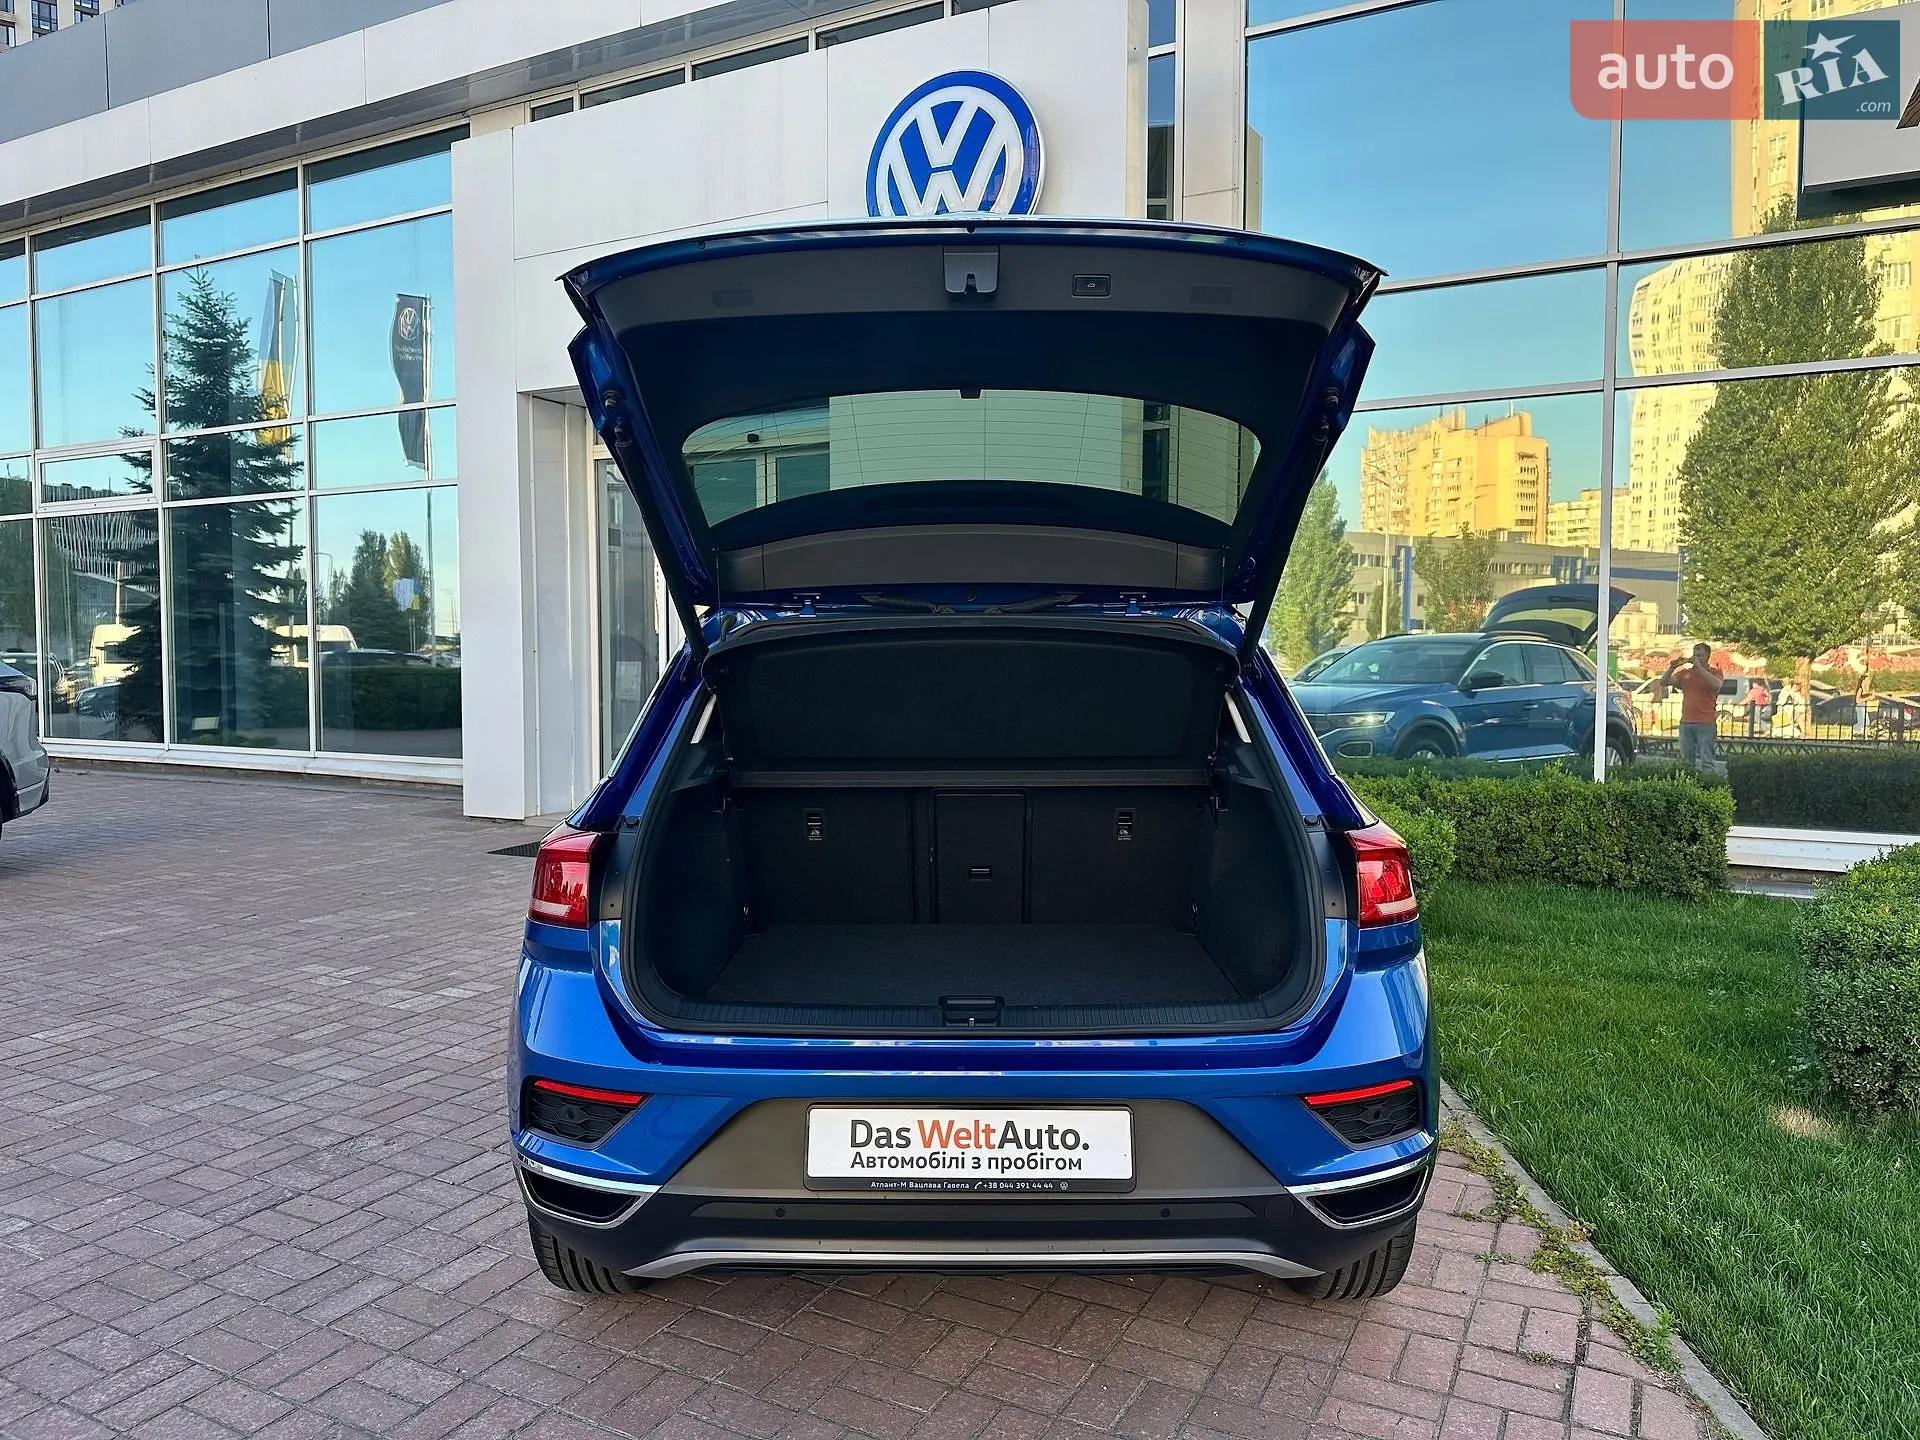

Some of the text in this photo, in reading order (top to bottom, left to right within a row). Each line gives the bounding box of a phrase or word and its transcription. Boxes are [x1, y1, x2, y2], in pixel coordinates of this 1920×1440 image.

[849, 1119, 1090, 1151] Das WeltAuto.
[849, 1150, 1083, 1174] Автомобілі з пробігом
[983, 1181, 998, 1190] +38
[999, 1181, 1014, 1190] 044
[1015, 1181, 1030, 1190] 391
[1031, 1181, 1042, 1190] 44
[1043, 1181, 1054, 1190] 44
